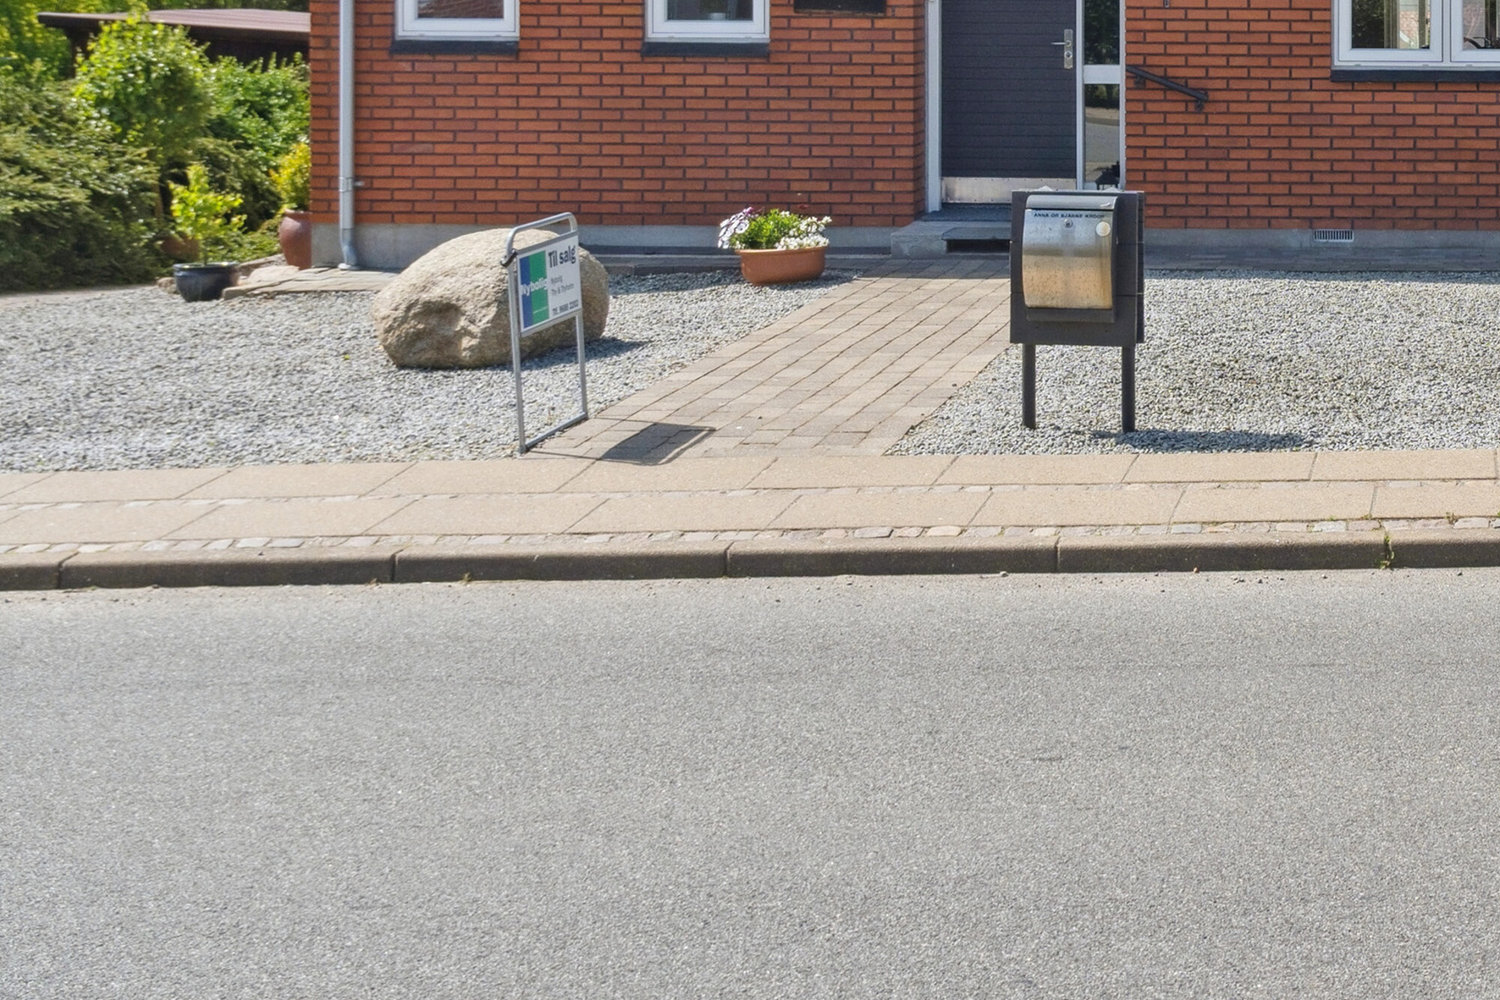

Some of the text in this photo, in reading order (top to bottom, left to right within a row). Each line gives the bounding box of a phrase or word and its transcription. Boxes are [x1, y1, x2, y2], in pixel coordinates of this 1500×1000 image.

[548, 245, 577, 268] Til salg
[520, 277, 548, 297] Nybolig
